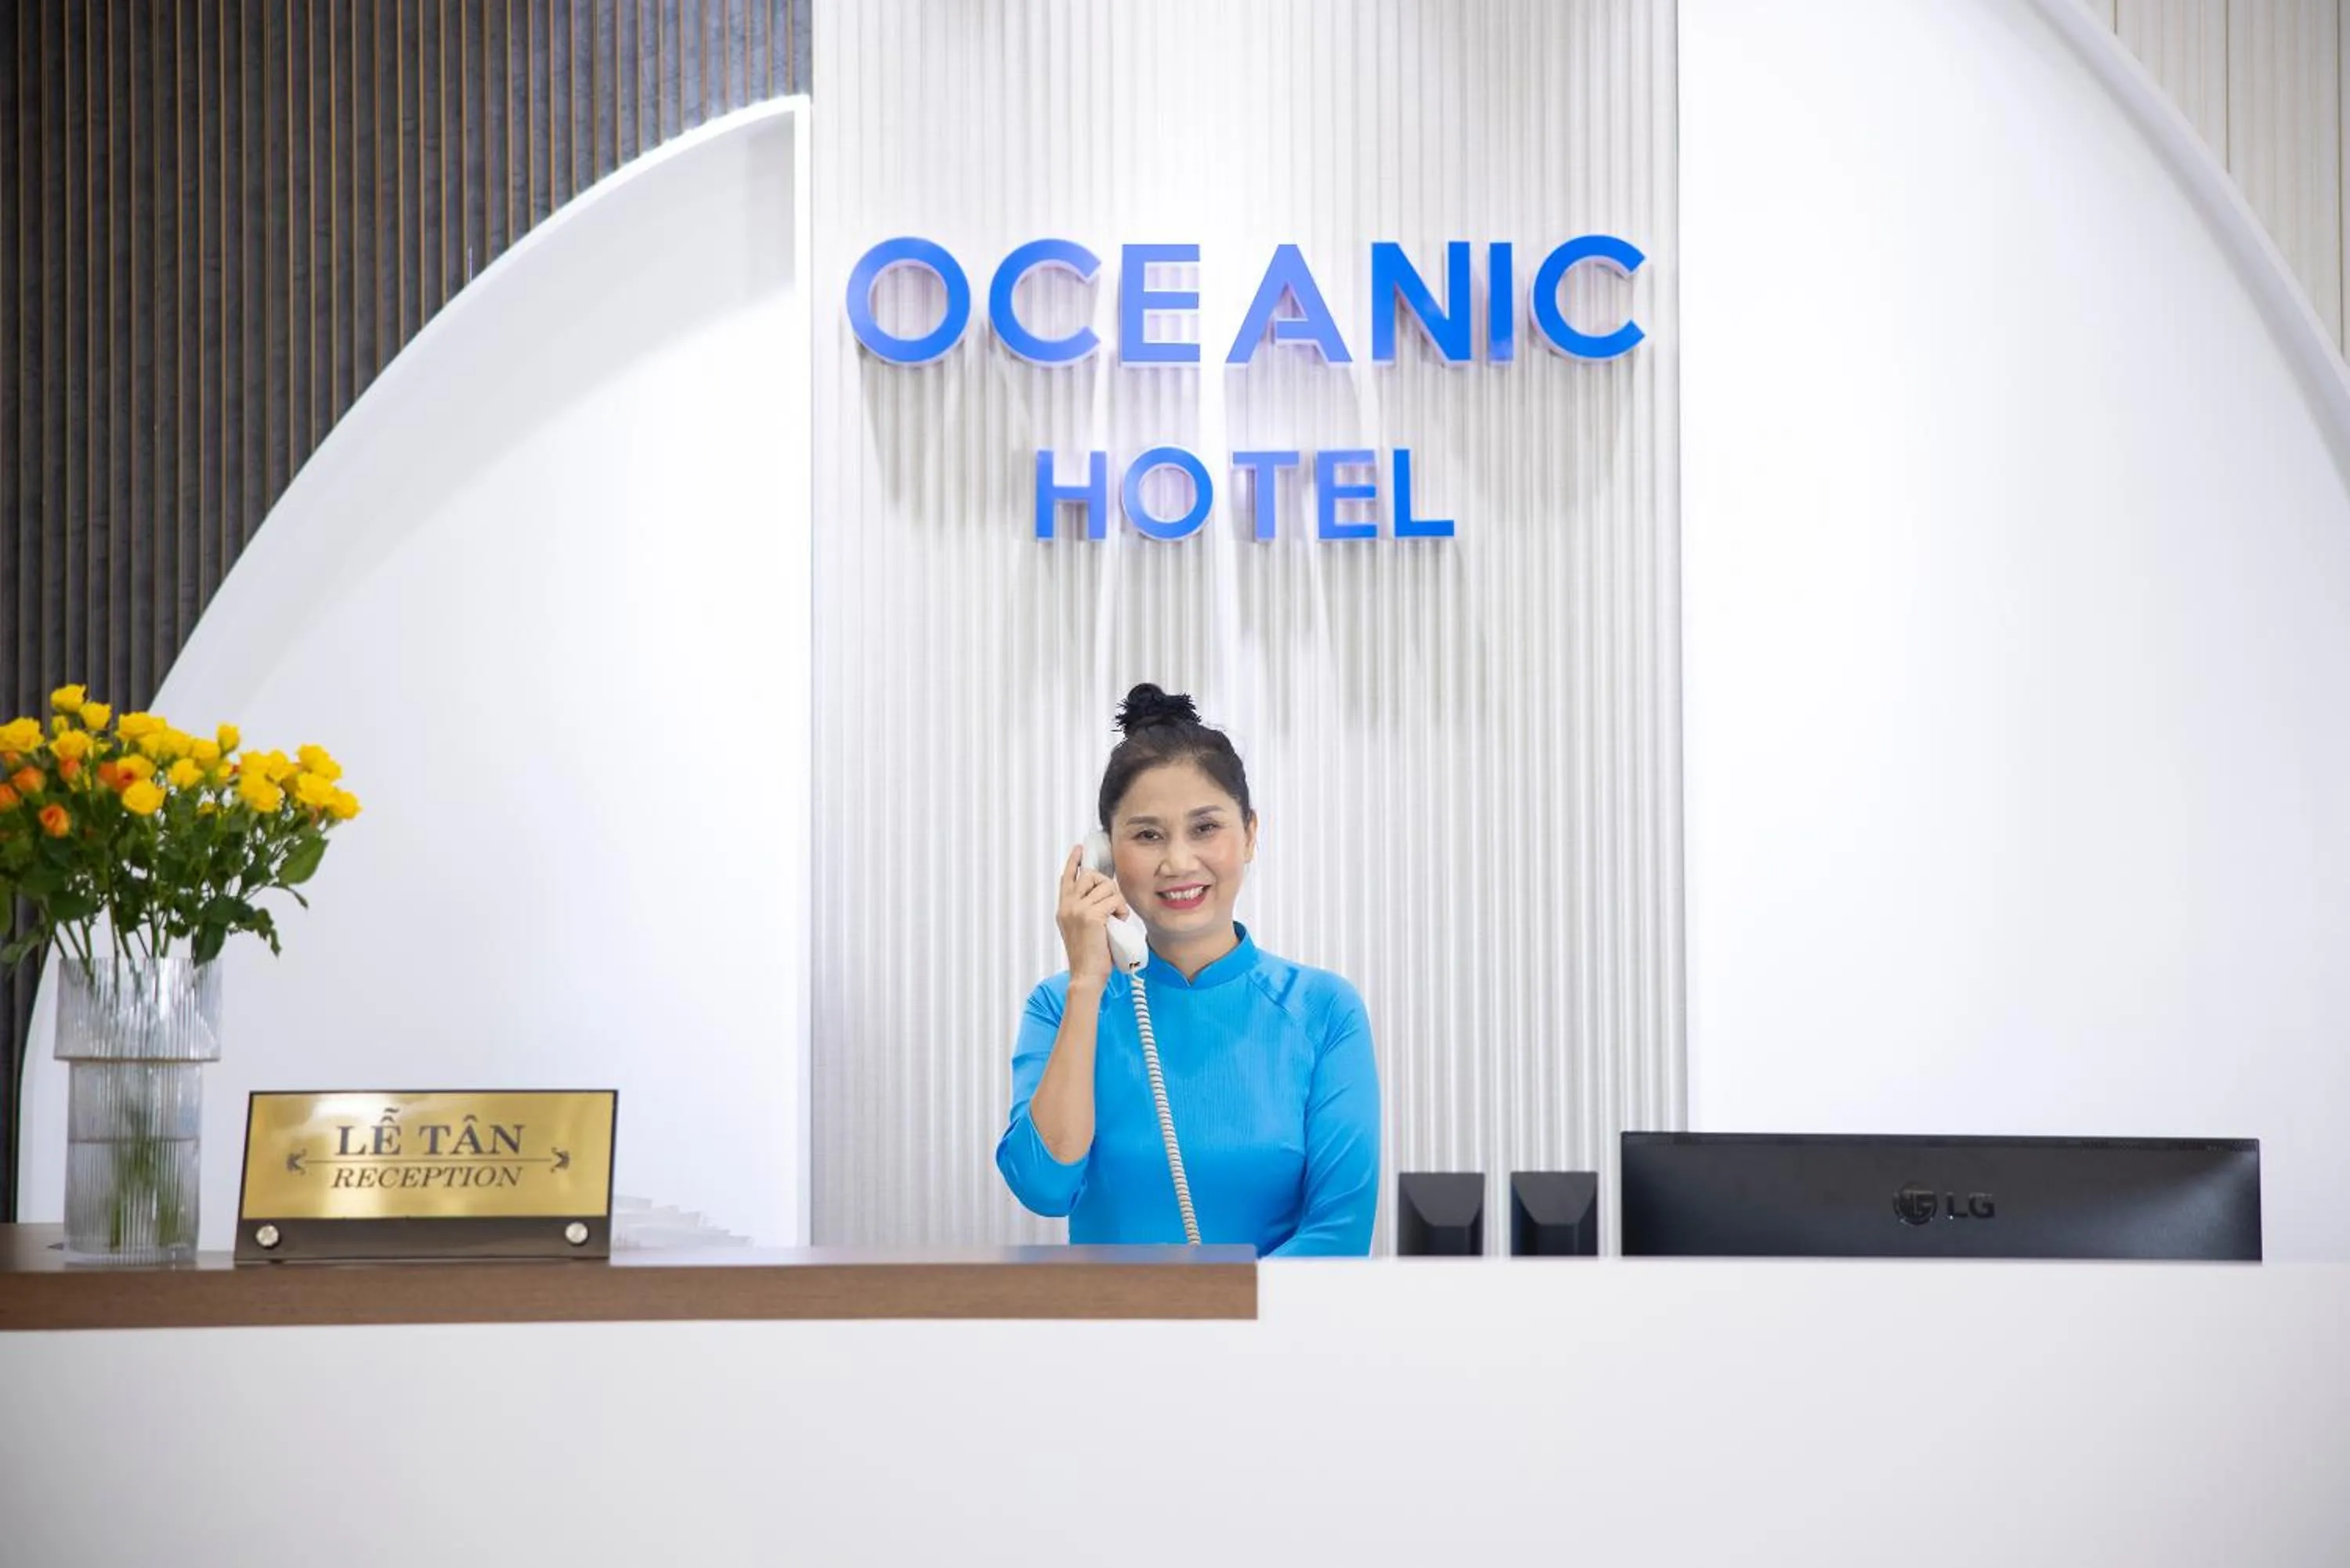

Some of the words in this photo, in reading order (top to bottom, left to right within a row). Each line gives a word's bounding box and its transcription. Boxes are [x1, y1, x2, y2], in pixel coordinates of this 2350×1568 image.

[846, 235, 1647, 363] OCEANIC
[1035, 446, 1455, 540] HOTEL
[335, 1107, 402, 1155] LỄ
[419, 1115, 526, 1155] TÂN
[331, 1166, 523, 1188] RECEPTION
[1946, 1192, 1995, 1219] LG
